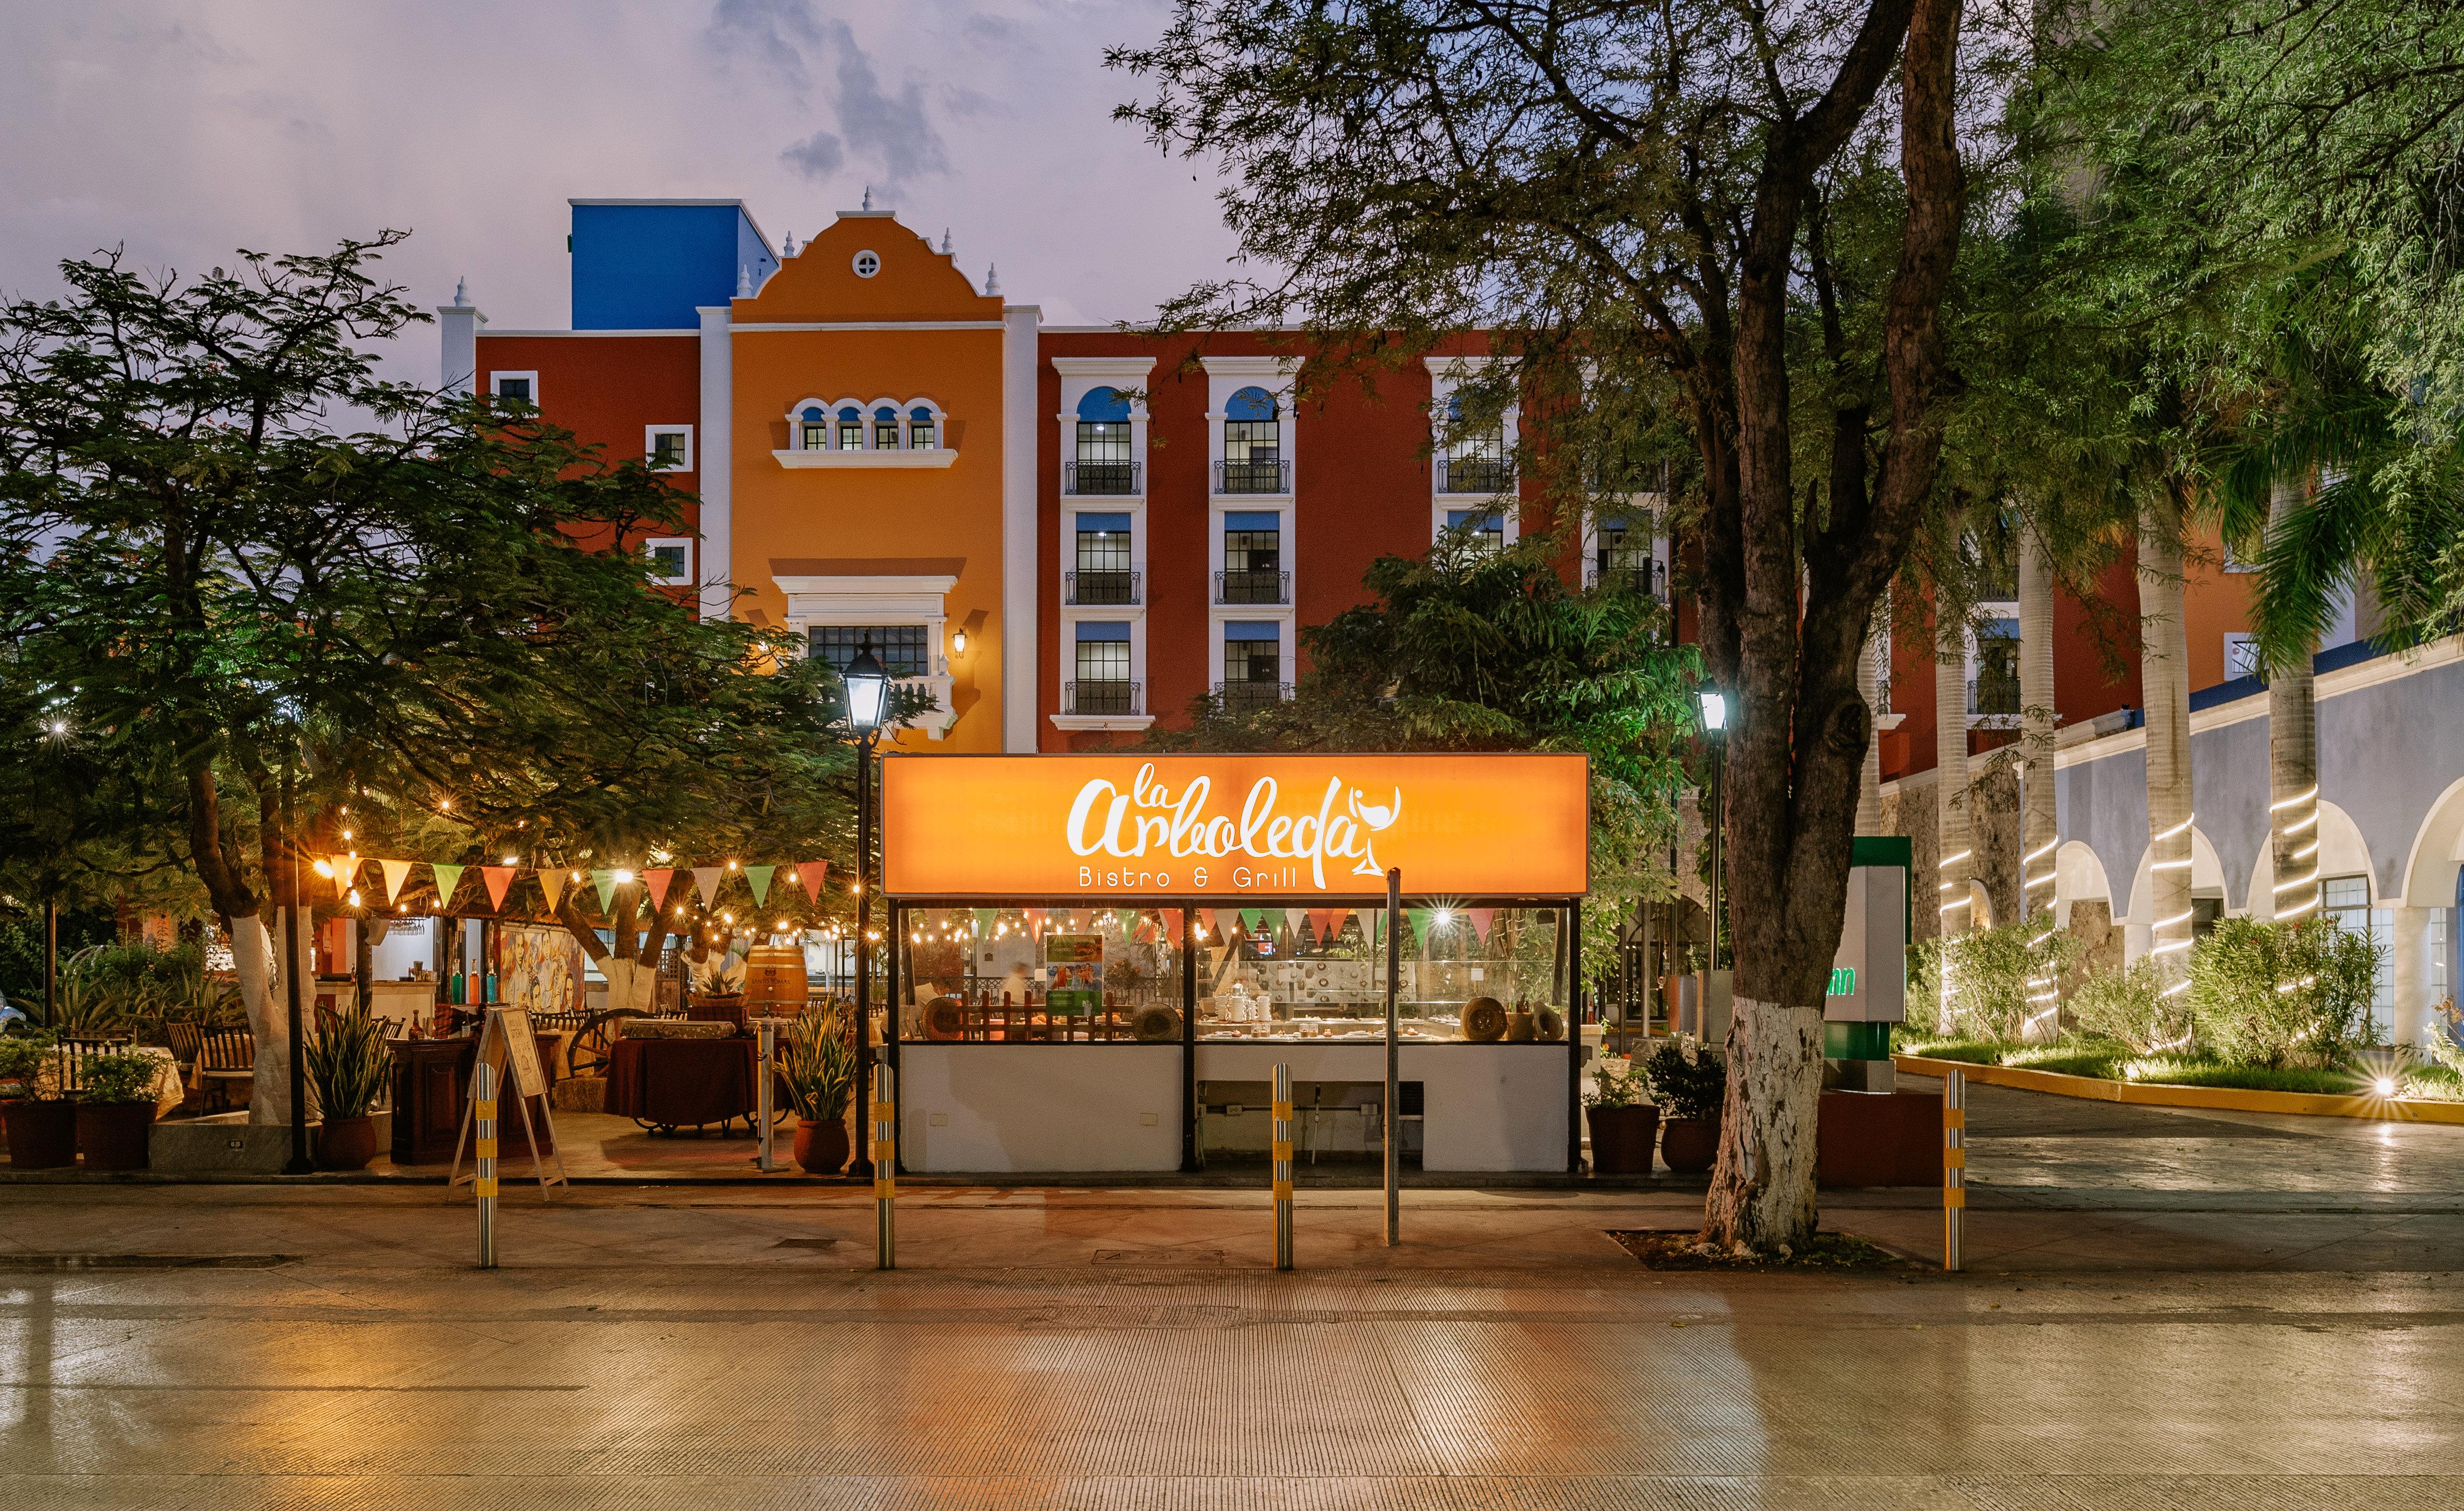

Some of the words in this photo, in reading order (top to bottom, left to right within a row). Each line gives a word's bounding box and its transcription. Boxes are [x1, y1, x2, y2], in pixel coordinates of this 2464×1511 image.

[1133, 762, 1177, 808] la
[1079, 866, 1170, 887] Bistro
[1194, 866, 1208, 887] &
[1233, 866, 1295, 888] Grill
